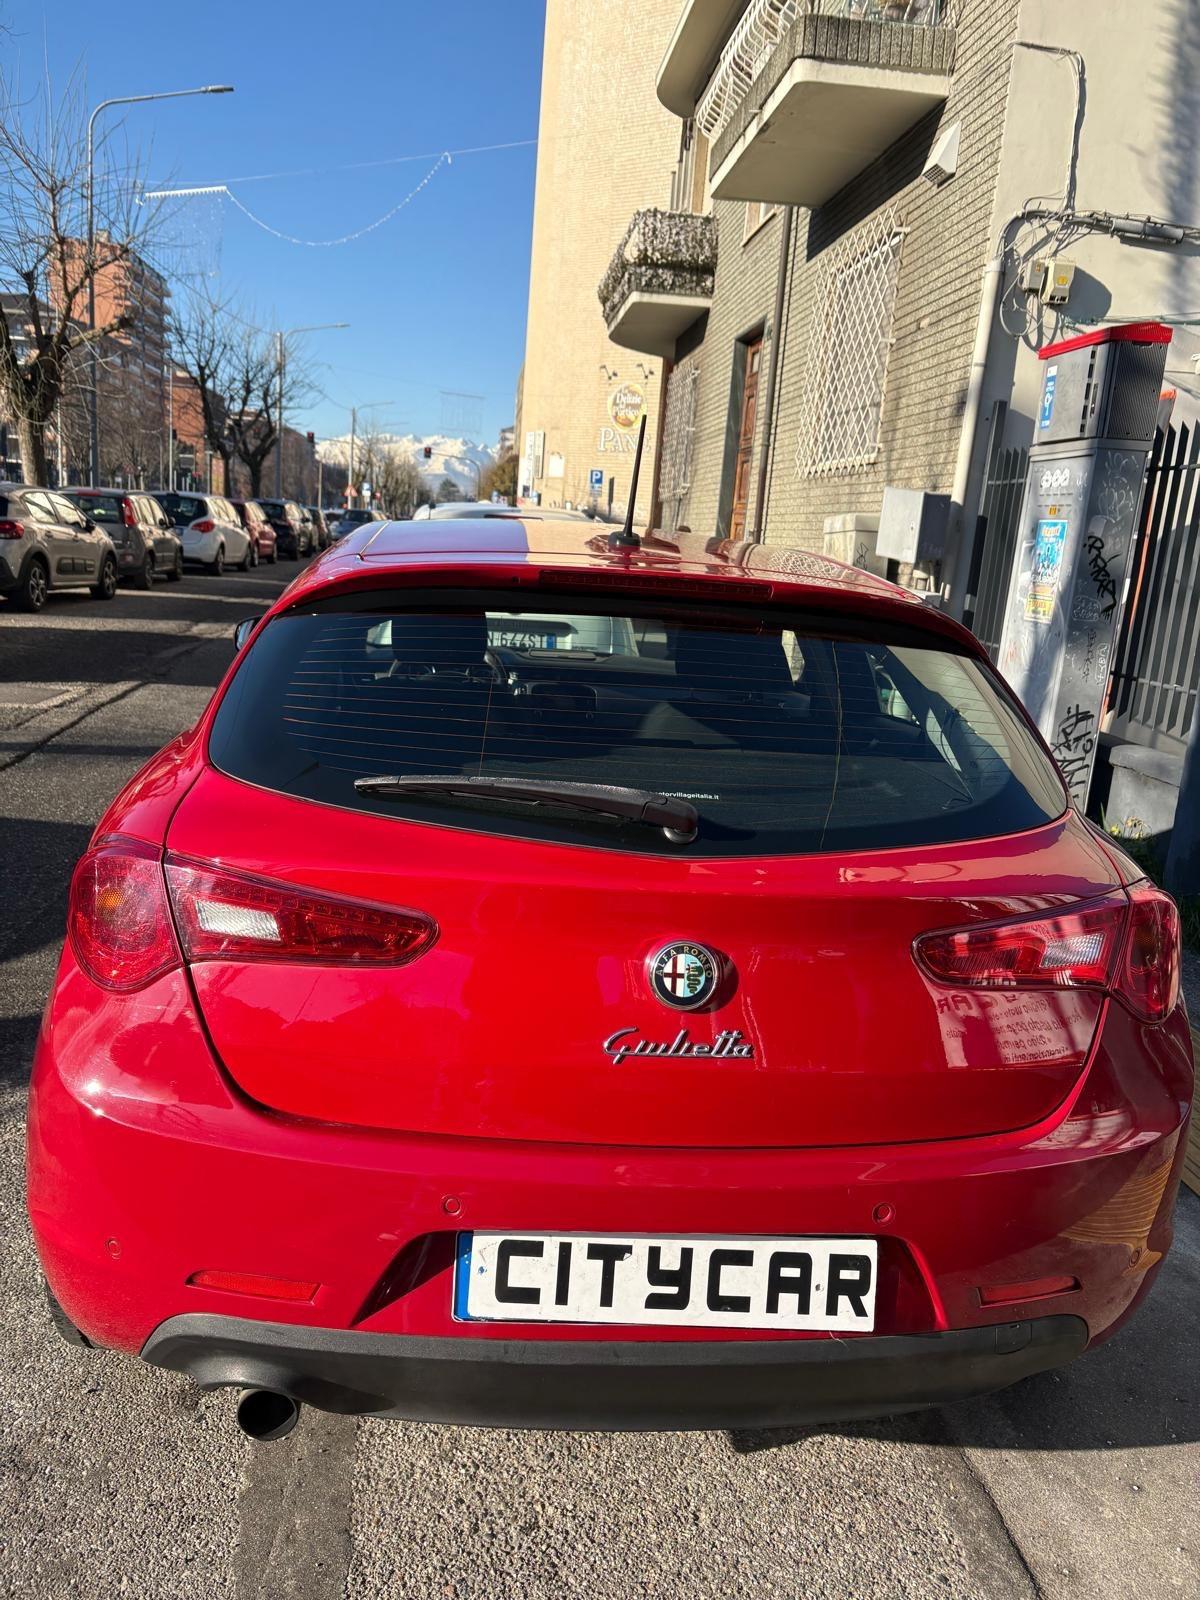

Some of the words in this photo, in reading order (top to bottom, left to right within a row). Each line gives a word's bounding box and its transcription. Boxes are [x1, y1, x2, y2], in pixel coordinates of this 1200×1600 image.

[592, 471, 601, 484] P
[656, 949, 678, 977] ALFA
[683, 946, 713, 979] ROMEO
[603, 1026, 755, 1065] Giulietta
[495, 1238, 873, 1318] CITYCAR
